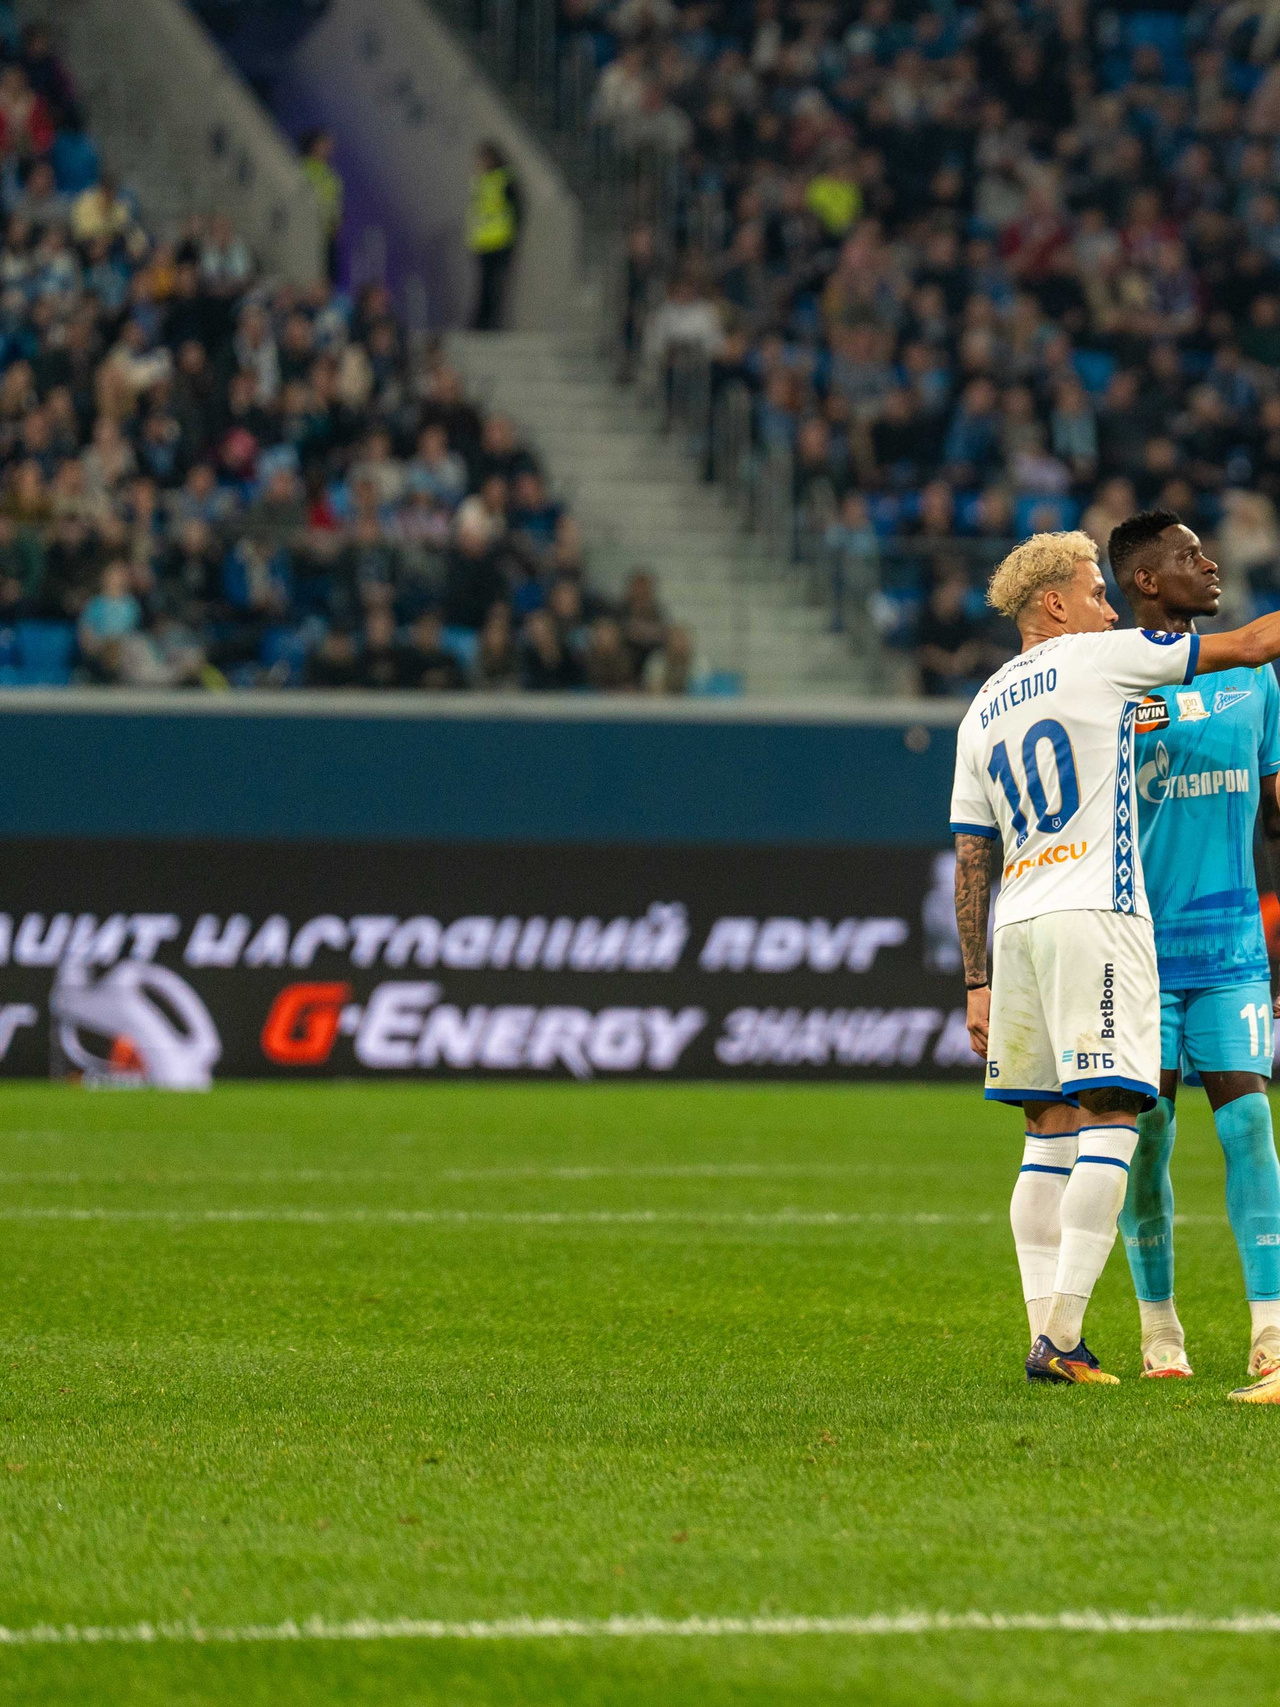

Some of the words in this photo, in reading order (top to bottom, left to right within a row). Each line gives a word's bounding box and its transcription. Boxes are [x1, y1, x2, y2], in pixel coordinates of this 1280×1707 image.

[979, 667, 1057, 730] БИТЕЛЛО
[1137, 706, 1166, 721] WIN
[987, 717, 1082, 849] 10
[1168, 768, 1250, 799] ГАЗПРОМ
[1100, 962, 1115, 1039] BetBoom
[1239, 1002, 1271, 1058] 11
[1077, 1052, 1115, 1070] ВТБ
